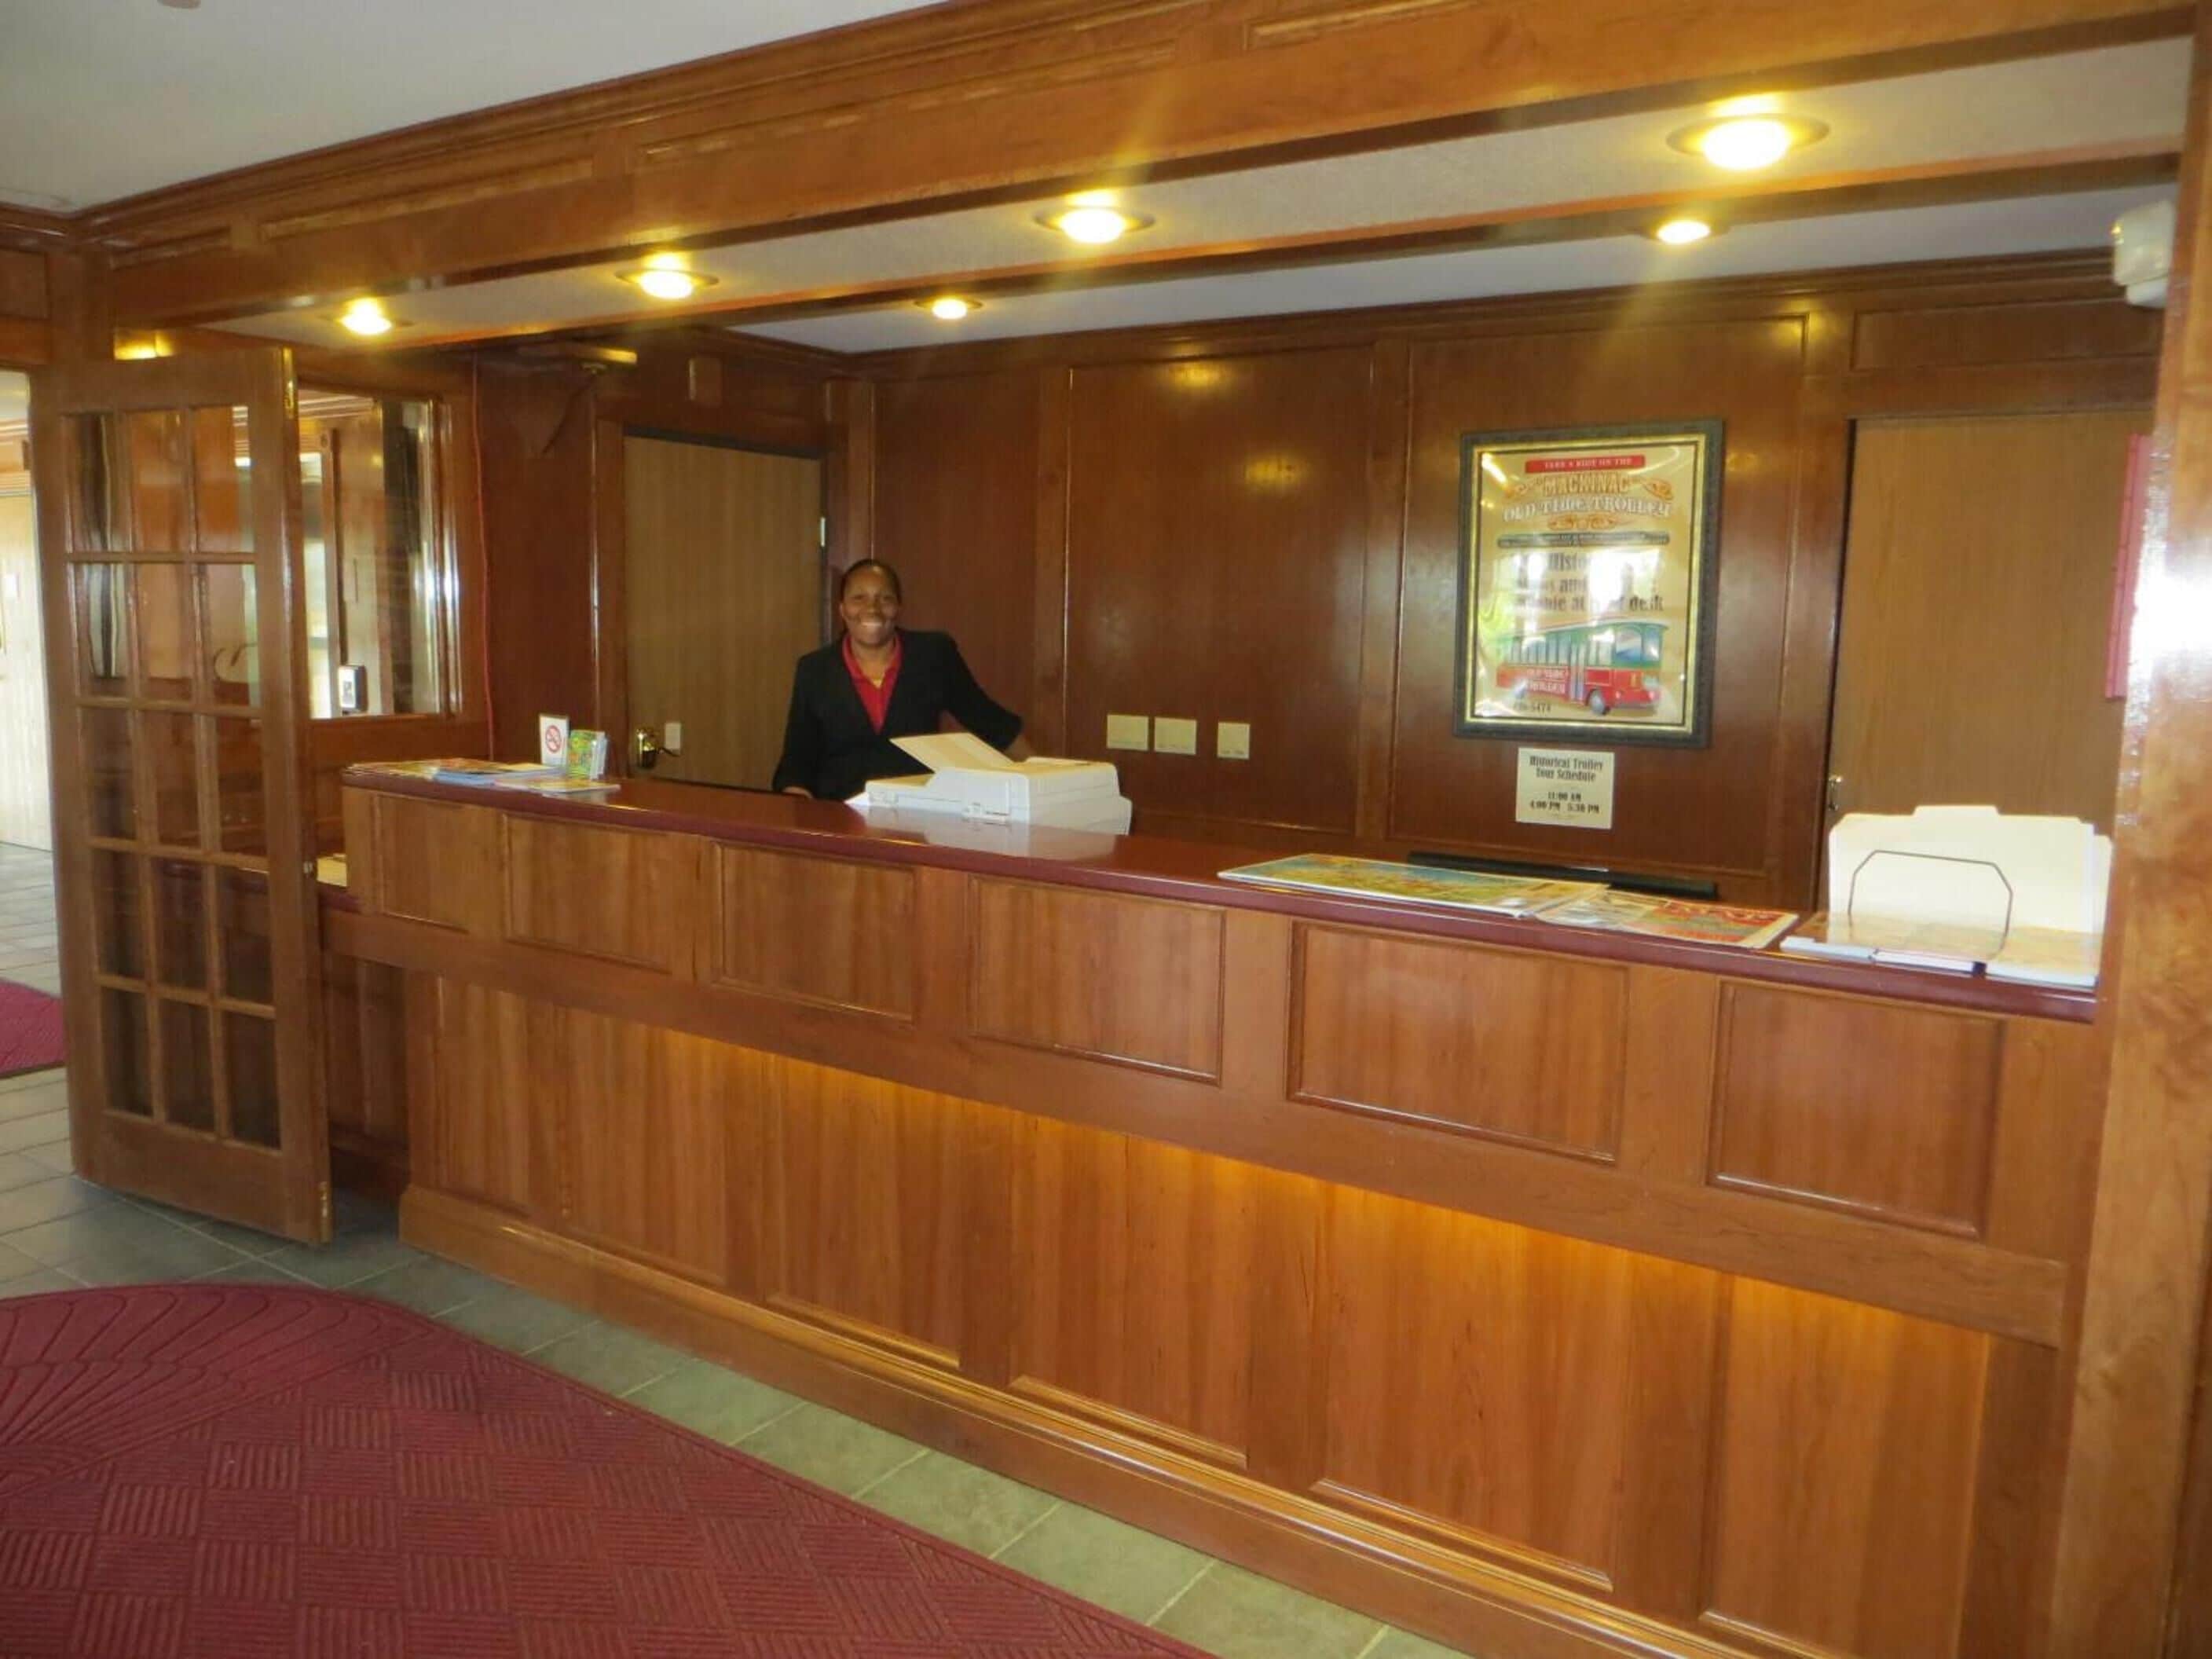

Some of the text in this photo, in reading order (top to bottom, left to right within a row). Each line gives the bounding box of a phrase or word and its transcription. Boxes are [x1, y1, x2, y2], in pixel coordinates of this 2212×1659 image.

[1614, 457, 1632, 466] THE
[1543, 472, 1629, 496] MACKINAC
[1503, 504, 1536, 522] OLD
[1529, 756, 1603, 771] Historical Trolley
[1536, 767, 1596, 782] Tour Schedule
[1549, 801, 1561, 811] PM
[1588, 804, 1599, 814] PM
